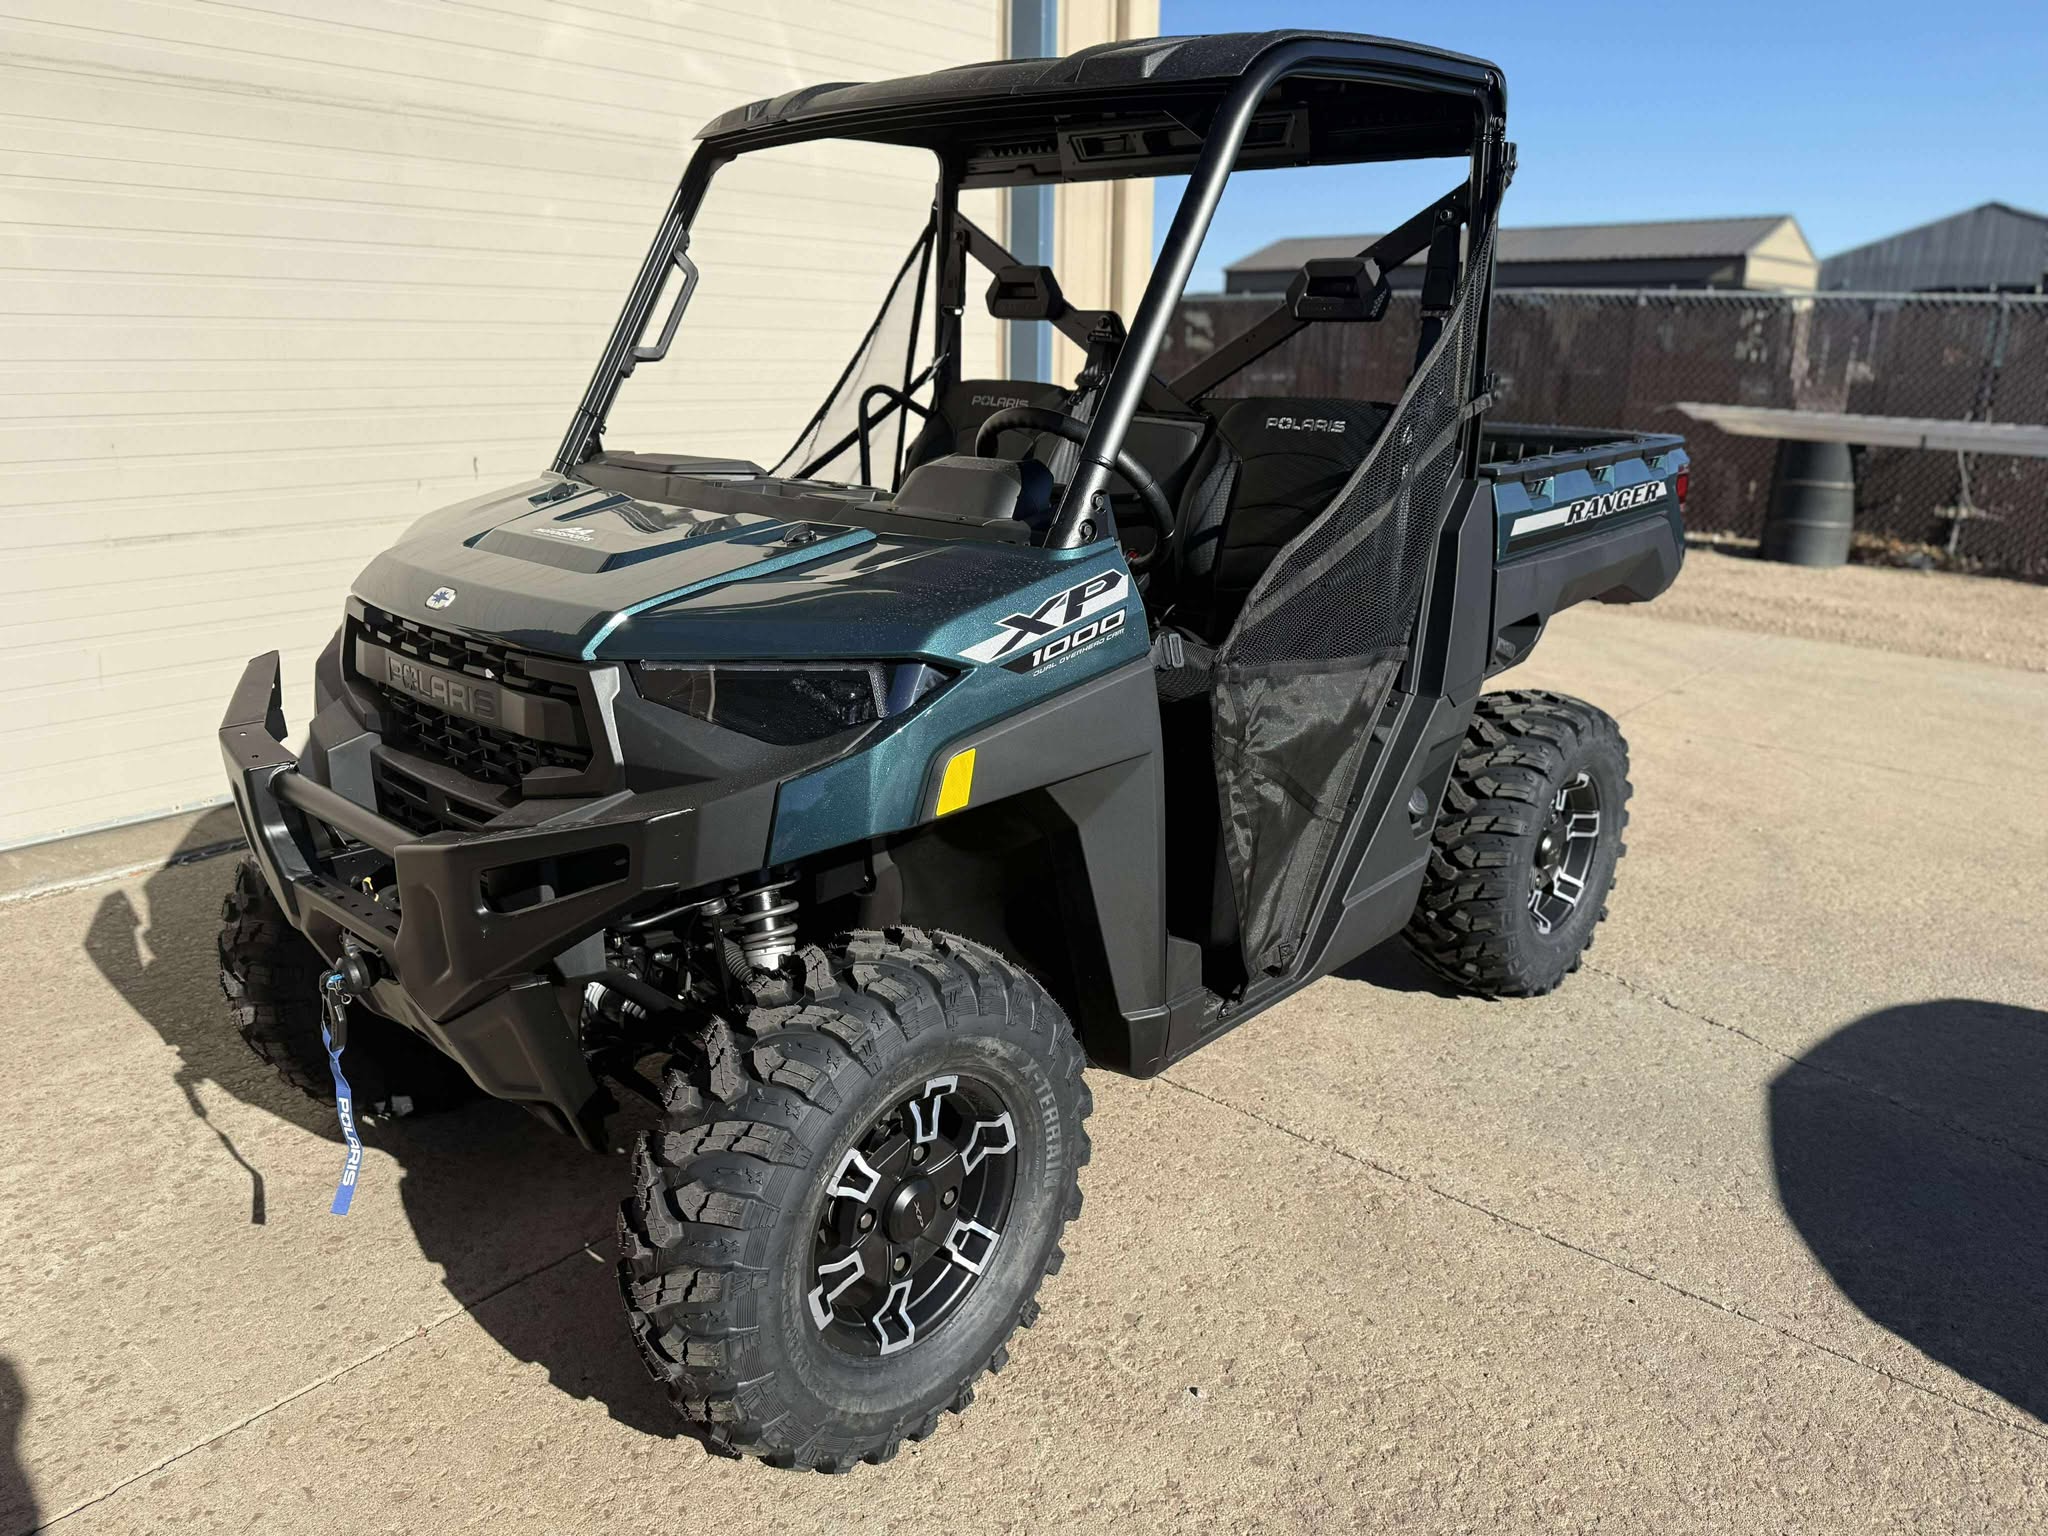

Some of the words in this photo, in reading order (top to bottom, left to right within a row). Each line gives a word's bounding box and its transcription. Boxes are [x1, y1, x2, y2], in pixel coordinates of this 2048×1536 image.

[971, 395, 1030, 408] POLARIS
[1265, 417, 1346, 433] POLARIS
[1565, 481, 1661, 526] RANGER
[990, 569, 1124, 661] XP
[1032, 608, 1125, 667] 1000
[1033, 662, 1057, 677] DUAL
[1060, 637, 1105, 664] OVERHEAD
[1106, 628, 1125, 641] CAM
[388, 656, 497, 721] POLARIS
[338, 1097, 361, 1187] POLARIS
[1018, 1057, 1062, 1188] X-TERRAIN
